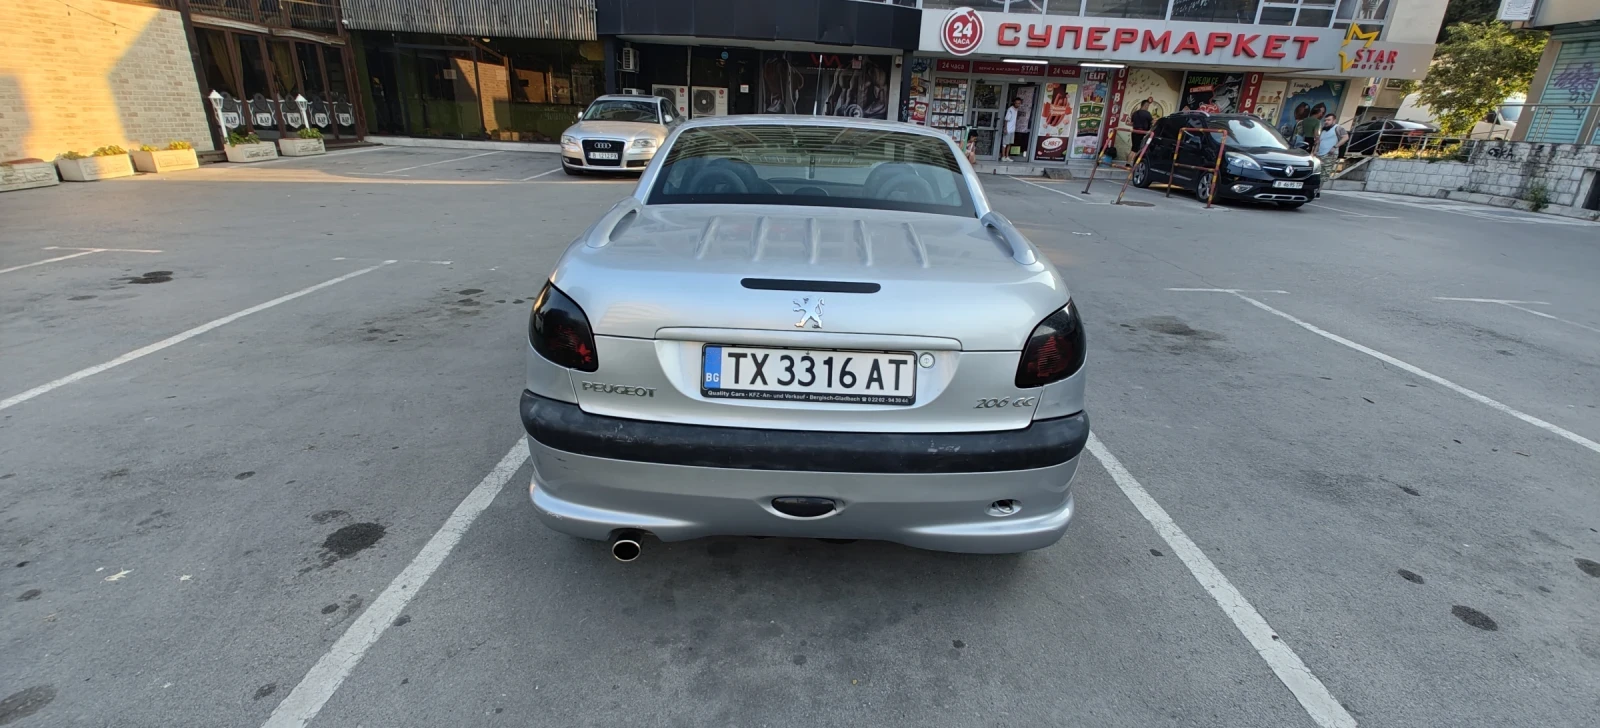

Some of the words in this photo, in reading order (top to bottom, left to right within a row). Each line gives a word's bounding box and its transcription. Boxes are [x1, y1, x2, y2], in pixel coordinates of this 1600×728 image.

[952, 21, 973, 38] 24
[997, 22, 1320, 60] СУПЕРМАРКЕТ
[1354, 48, 1399, 64] STAR
[1052, 67, 1061, 75] 24
[1351, 62, 1394, 71] market
[1088, 72, 1106, 80] ELIT
[705, 372, 720, 383] BG
[727, 352, 770, 386] TX
[776, 354, 857, 389] 3316
[865, 358, 908, 391] AT
[581, 380, 658, 398] PEUGEOT
[973, 395, 1010, 409] 206
[1012, 396, 1036, 408] CC
